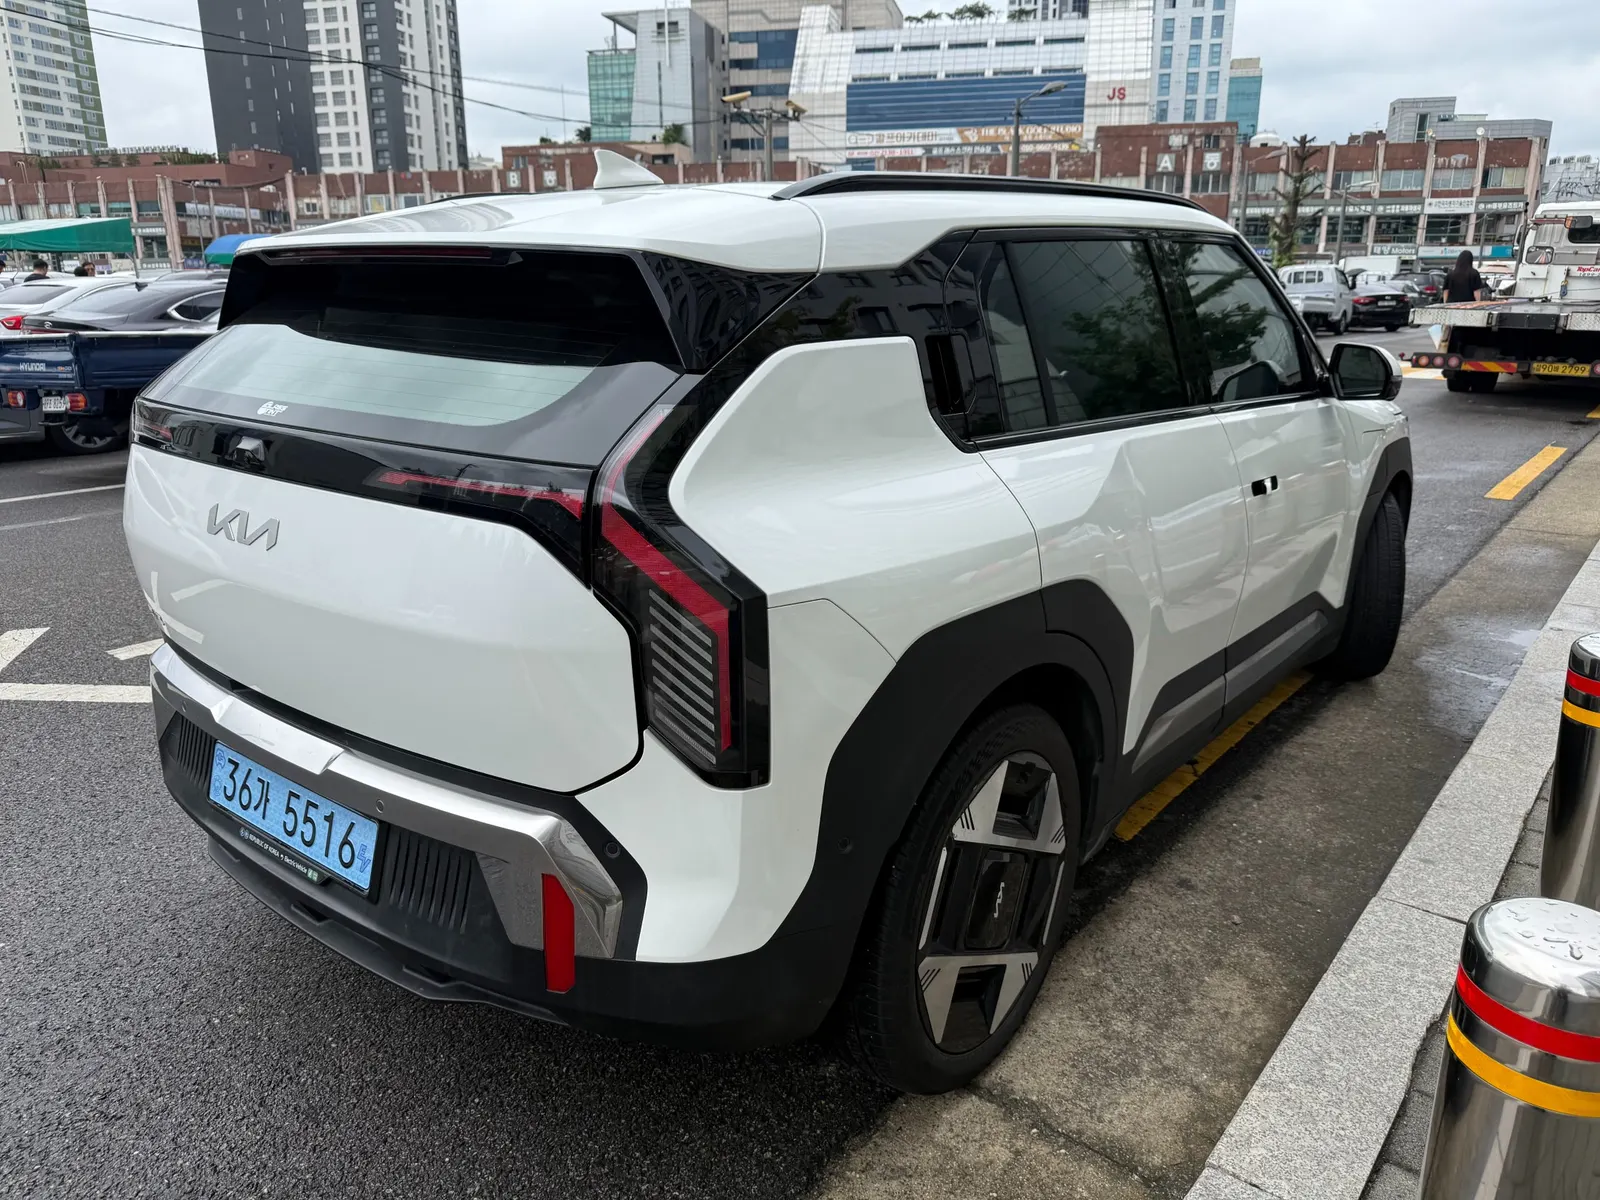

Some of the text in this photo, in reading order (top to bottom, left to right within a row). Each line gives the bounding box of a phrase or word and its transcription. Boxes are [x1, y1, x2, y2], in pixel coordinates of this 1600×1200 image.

[1107, 87, 1126, 100] JS
[1158, 154, 1174, 171] A
[510, 171, 519, 187] B
[1391, 247, 1416, 255] Motors
[20, 363, 46, 371] HYUNDAI
[1561, 365, 1587, 374] 2799
[206, 502, 280, 552] KIA
[223, 757, 356, 870] 36가 5516
